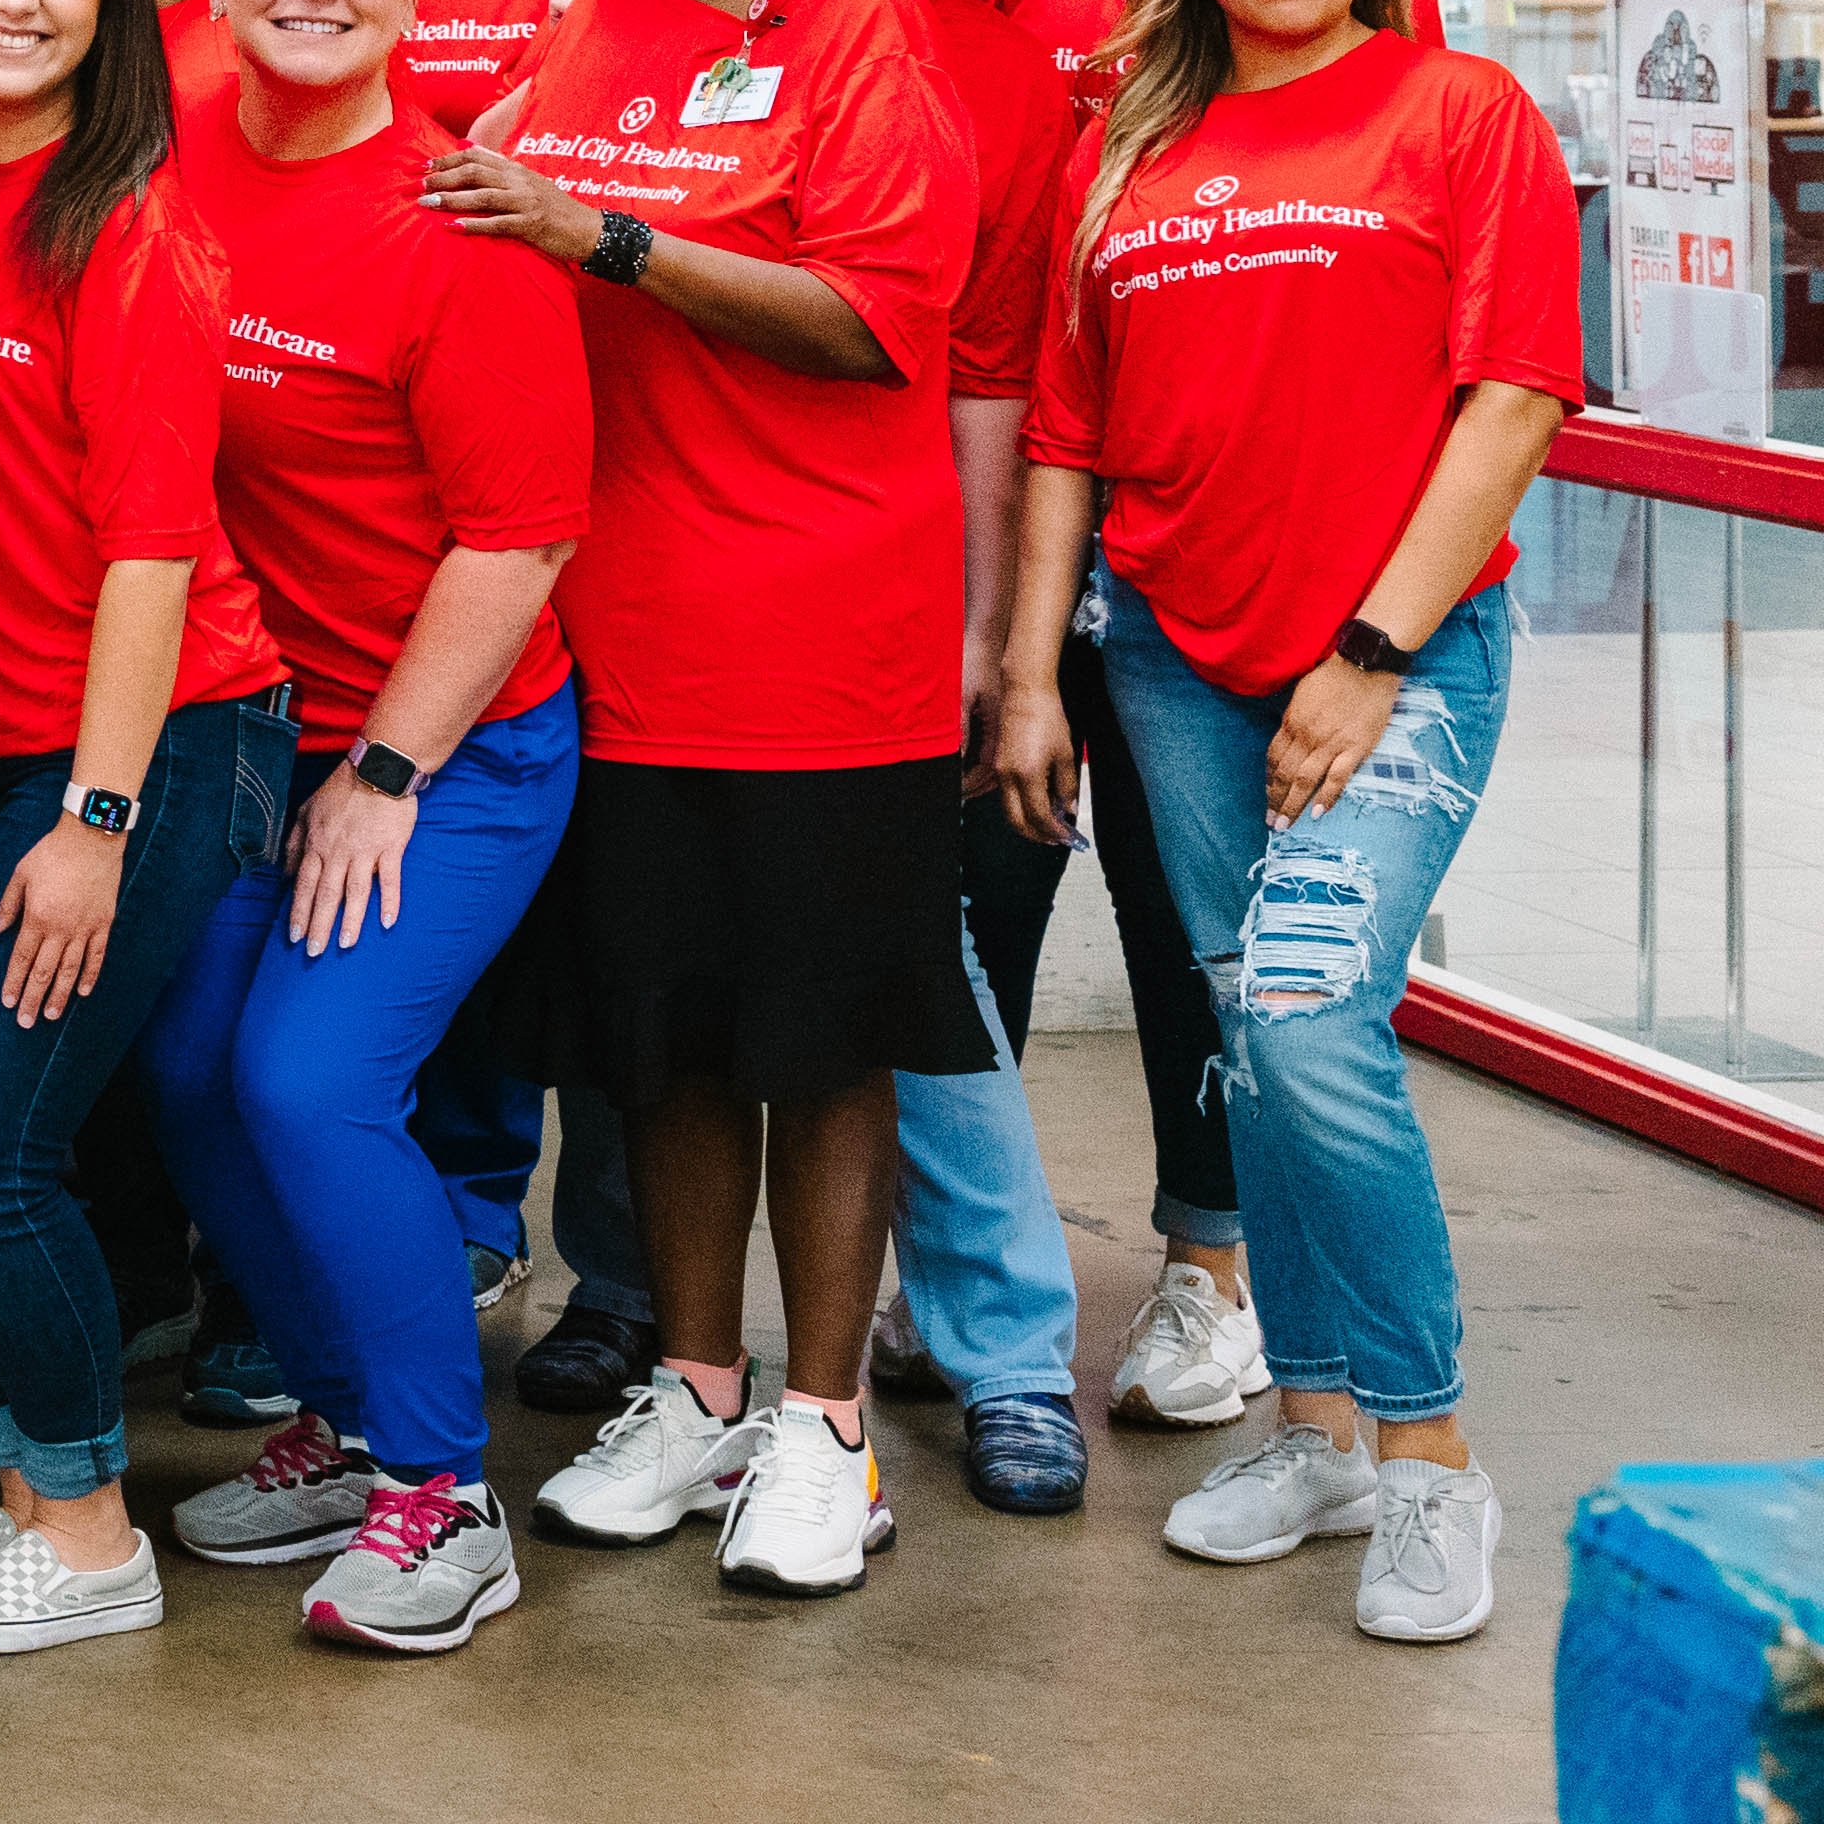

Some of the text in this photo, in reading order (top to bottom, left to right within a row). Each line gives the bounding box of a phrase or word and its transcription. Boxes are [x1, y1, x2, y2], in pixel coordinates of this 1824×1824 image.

[577, 136, 626, 167] City
[621, 141, 740, 173] Healthcare
[555, 174, 690, 205] for the Community
[1159, 214, 1218, 244] City
[1223, 199, 1384, 232] Healthcare
[1160, 263, 1189, 284] for
[1191, 259, 1221, 279] the
[1224, 243, 1338, 272] Community
[229, 313, 336, 363] lthcare
